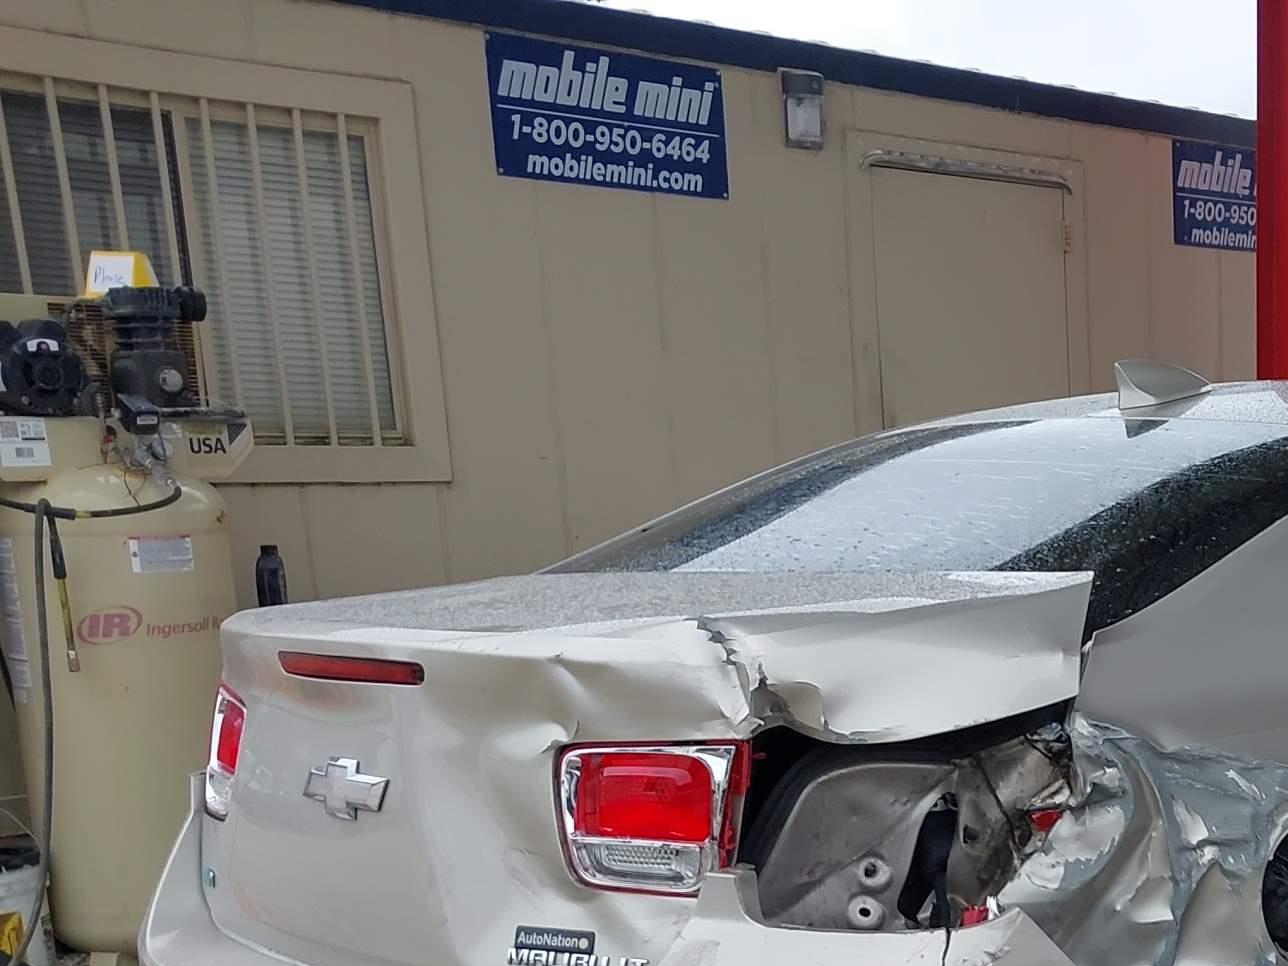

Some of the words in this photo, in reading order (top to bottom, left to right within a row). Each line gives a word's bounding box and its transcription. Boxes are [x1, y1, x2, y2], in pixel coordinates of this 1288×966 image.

[497, 50, 628, 113] mobile
[633, 76, 715, 126] mini
[511, 113, 711, 164] 1-800-950-6464
[527, 153, 703, 192] mobilemini.com
[1177, 150, 1252, 195] mobile
[189, 437, 227, 454] USA
[87, 613, 130, 638] IR
[146, 616, 209, 638] Ingersoll
[516, 931, 579, 949] AutoNation
